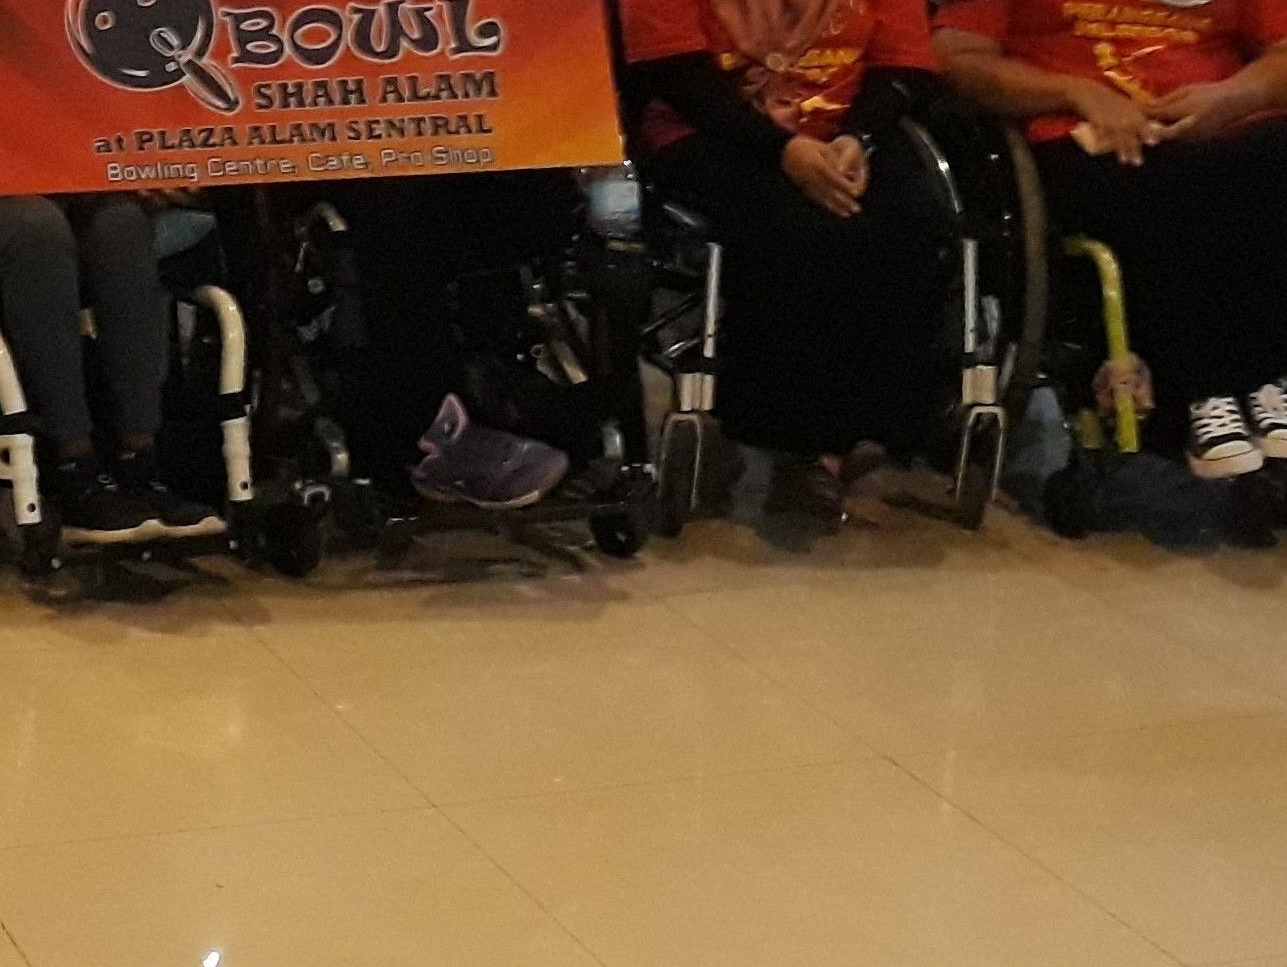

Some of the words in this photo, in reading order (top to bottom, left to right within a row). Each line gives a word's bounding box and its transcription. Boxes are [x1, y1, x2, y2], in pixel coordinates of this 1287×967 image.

[253, 77, 368, 110] SHAH
[378, 69, 500, 104] ALAM
[94, 134, 127, 155] at
[133, 125, 239, 151] PLAZA
[246, 120, 339, 146] ALAM
[346, 113, 494, 142] SENTRAL
[107, 160, 200, 182] Bowling
[379, 146, 424, 167] Pro
[431, 144, 493, 169] Shop
